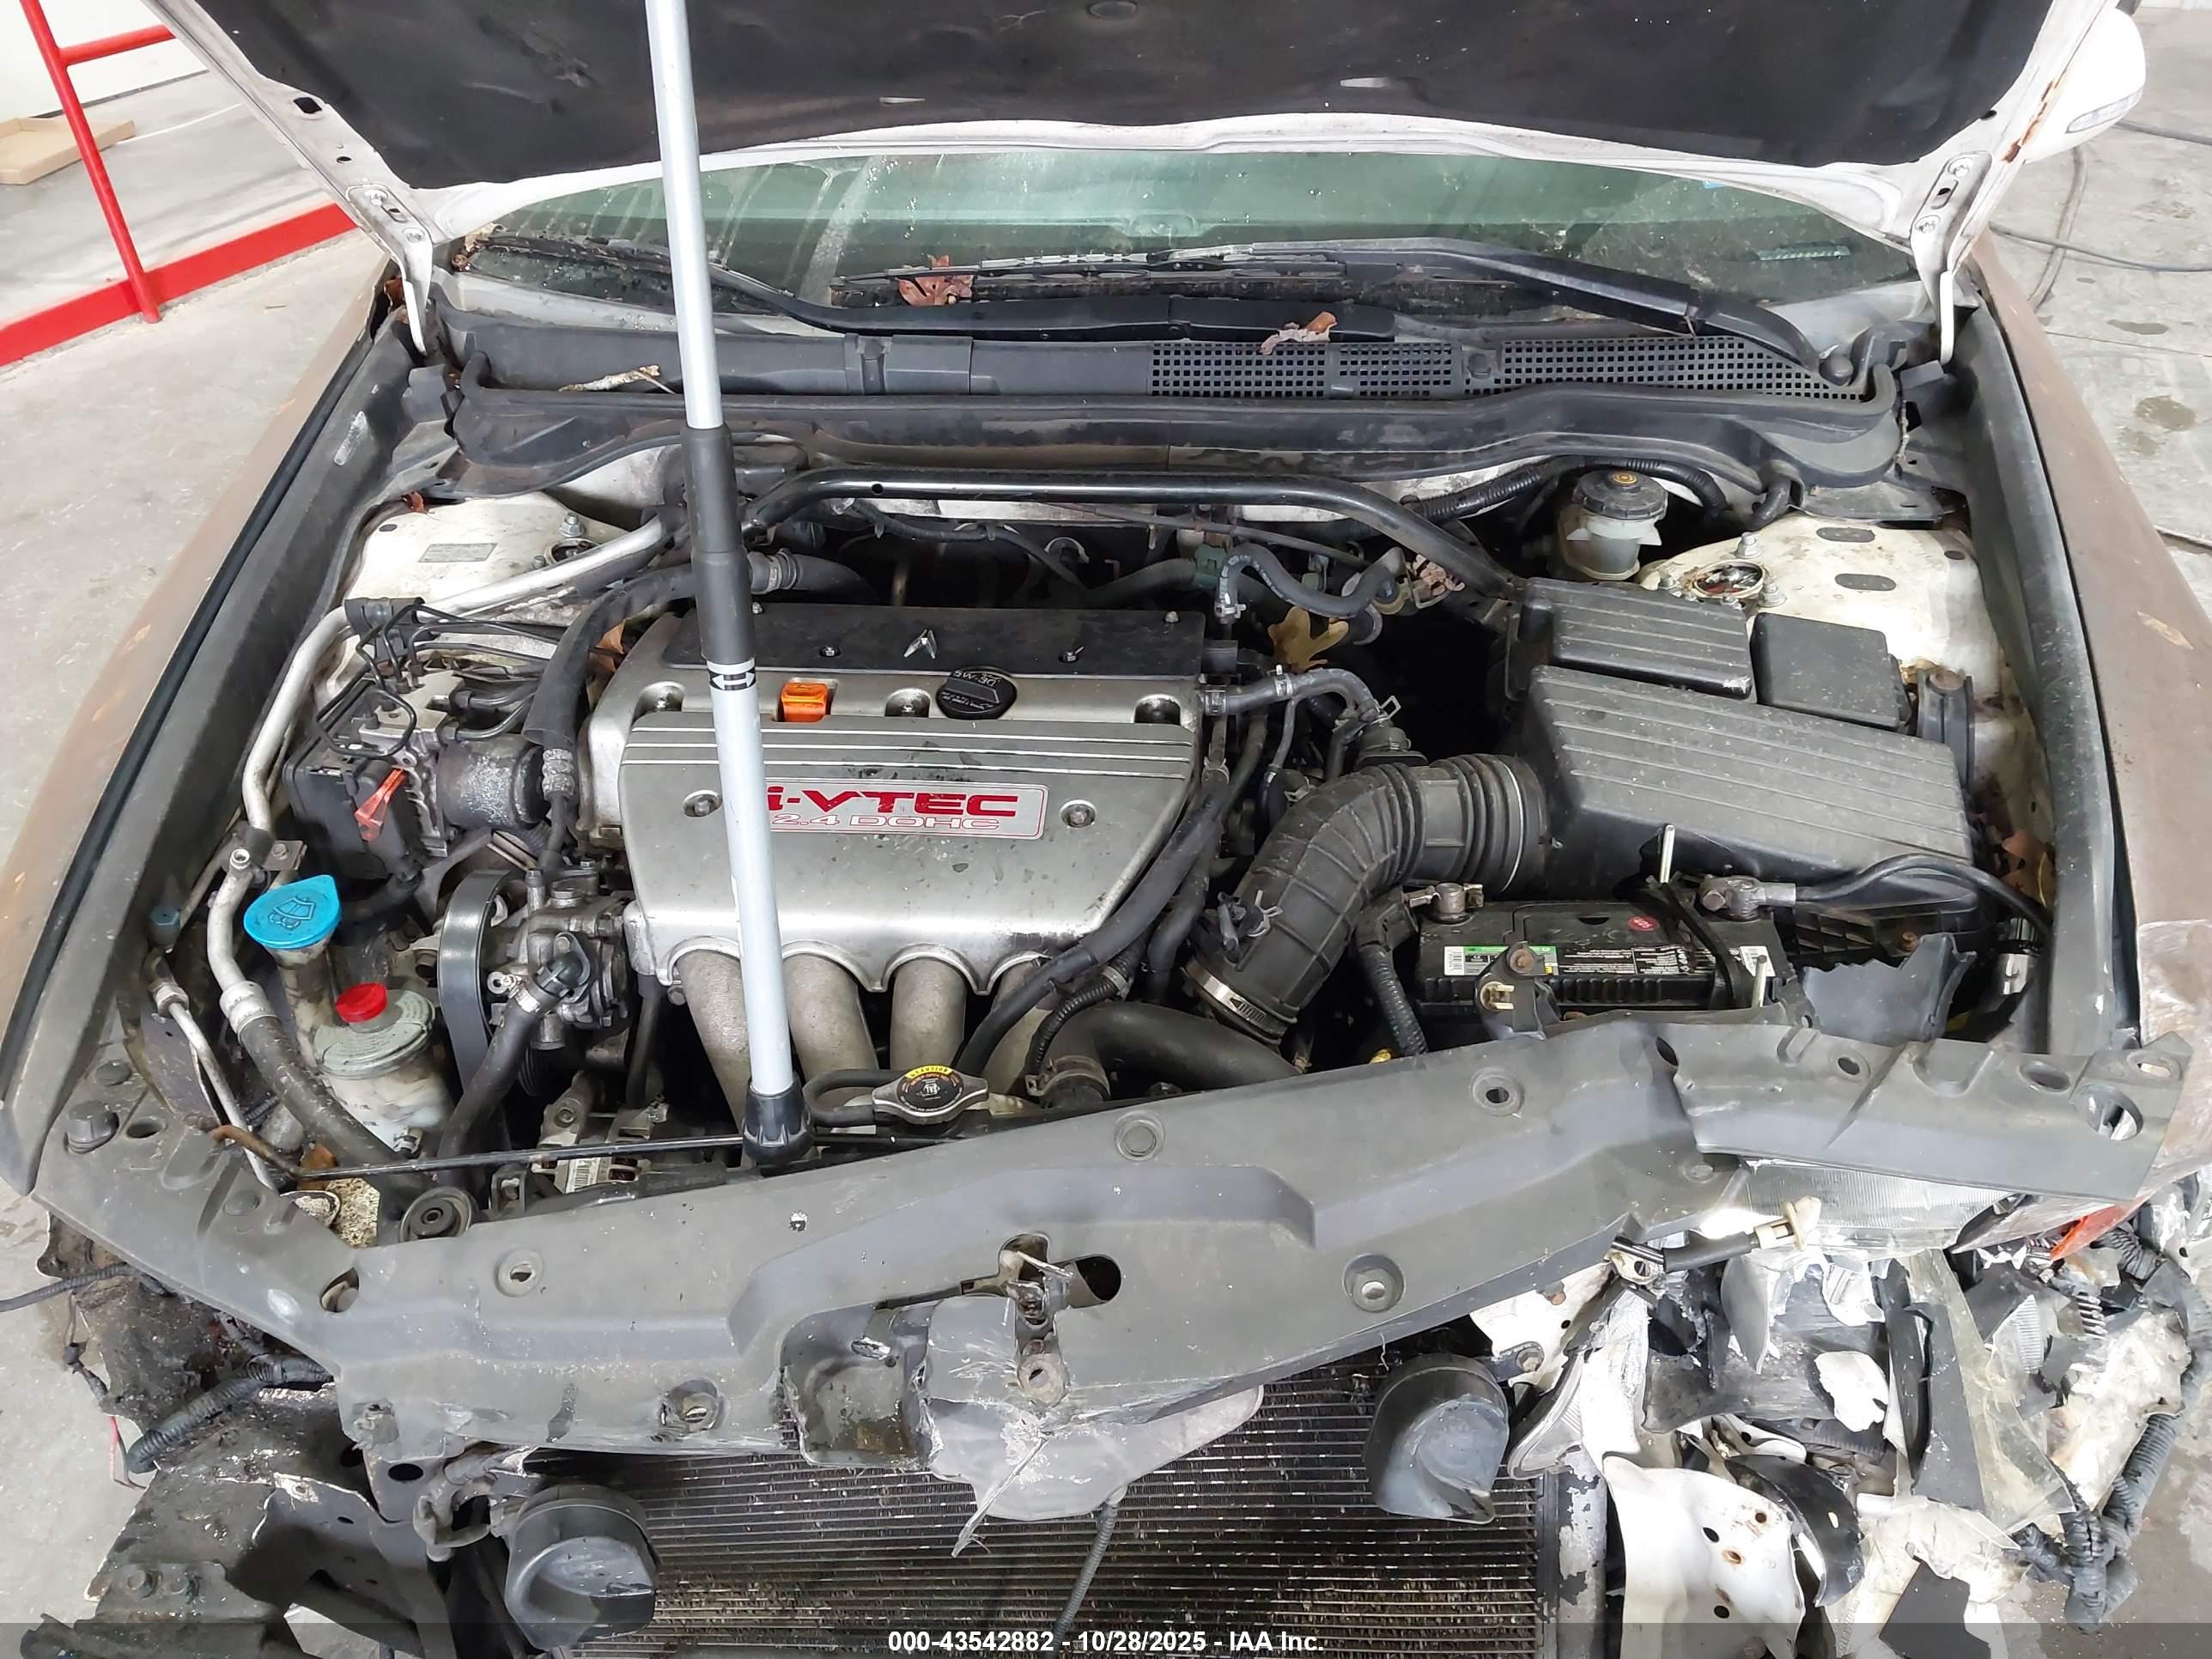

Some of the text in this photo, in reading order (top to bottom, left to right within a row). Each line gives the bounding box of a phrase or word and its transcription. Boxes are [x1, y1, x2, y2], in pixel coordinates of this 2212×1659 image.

[767, 786, 1018, 817] i-VTEC
[772, 812, 1001, 830] 2.4 DOHC
